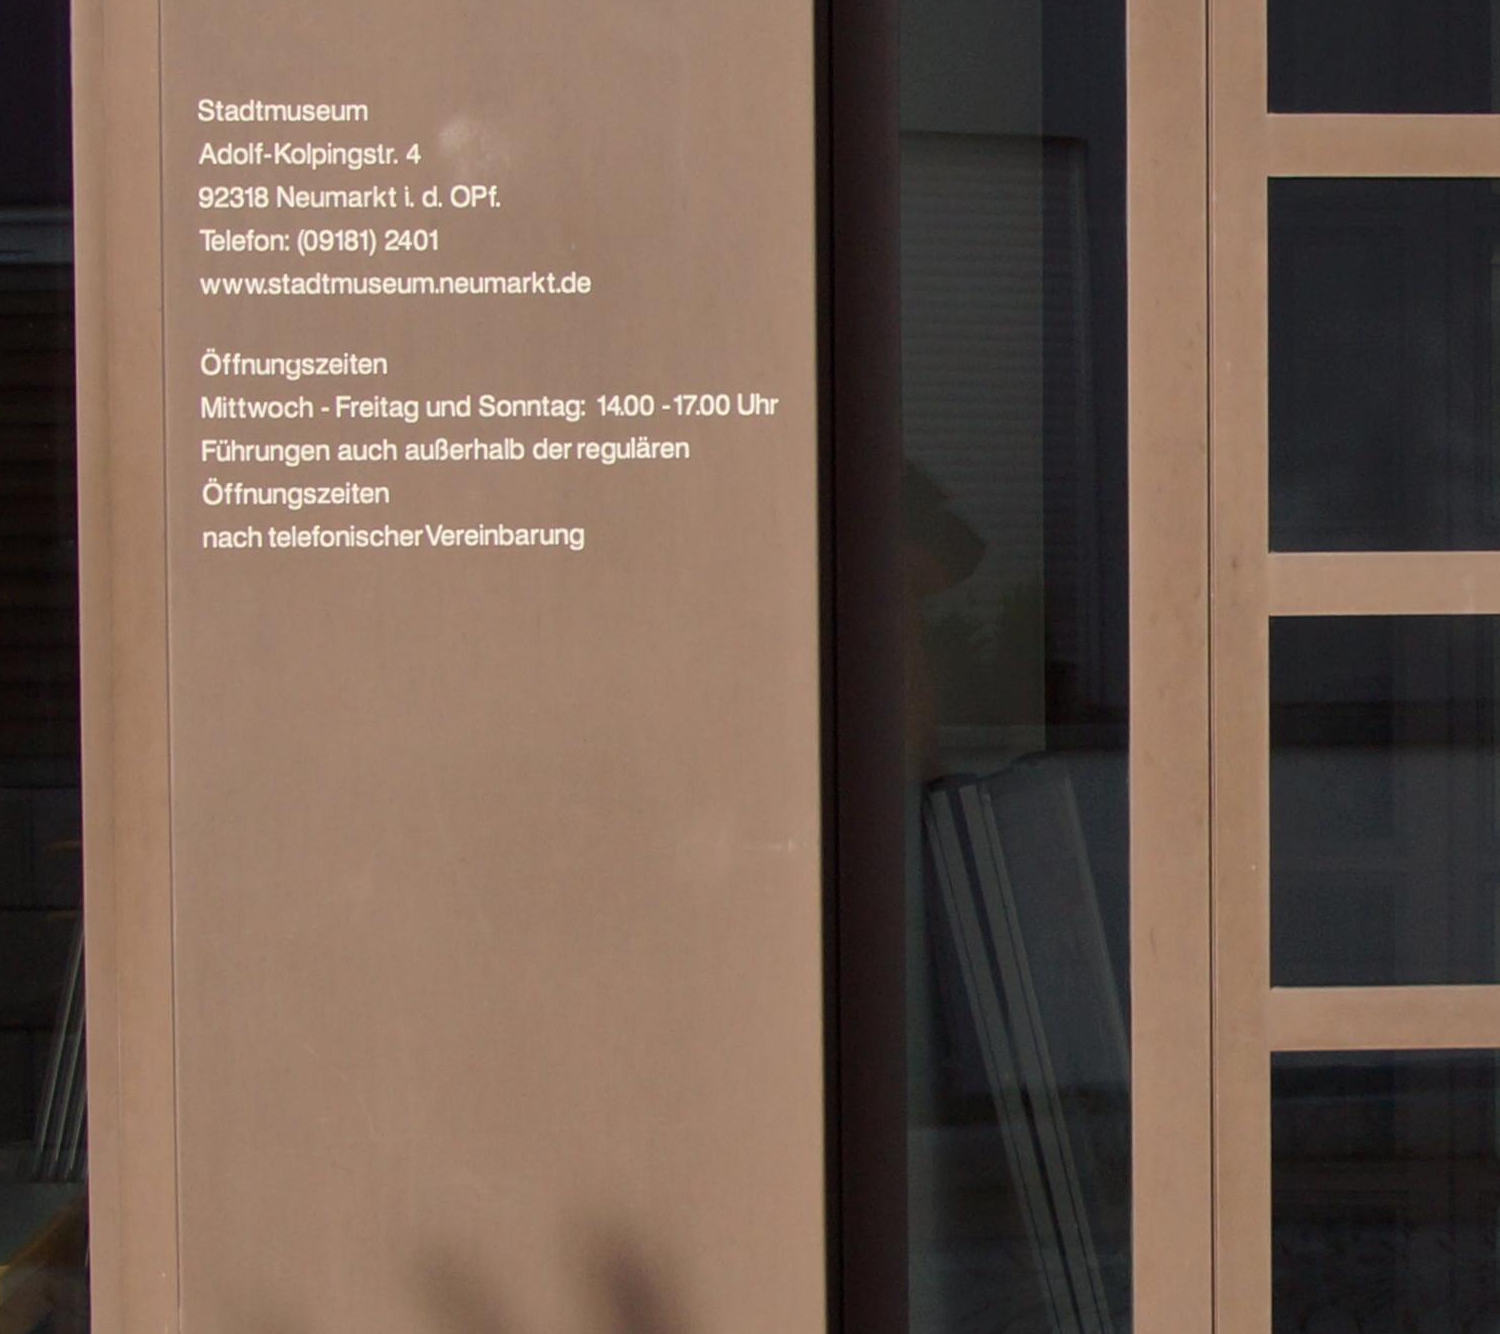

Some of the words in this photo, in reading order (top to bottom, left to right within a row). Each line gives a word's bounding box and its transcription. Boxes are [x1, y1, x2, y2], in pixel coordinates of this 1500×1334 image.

[197, 98, 369, 122] Stadtmuseum
[198, 141, 399, 171] Adolf-Kolpingstr.
[405, 142, 422, 165] 4
[197, 185, 270, 209] 92318
[276, 185, 397, 209] Neumarkt
[403, 185, 415, 208] i.
[421, 184, 443, 208] d.
[449, 184, 501, 209] OPf.
[198, 228, 291, 252] Telefon:
[296, 228, 377, 257] (09181)
[384, 228, 439, 252] 2401
[199, 270, 592, 296] www.stadtmuseum.neumarkt.de
[200, 347, 388, 382] Öffnungszeiten
[200, 395, 314, 419] Mittwoch
[335, 394, 420, 424] Freitag
[425, 394, 472, 418] und
[478, 394, 586, 423] Sonntag:
[596, 394, 655, 417] 14.00
[736, 392, 780, 416] Uhr
[201, 439, 331, 468] Führungen
[337, 438, 398, 462] auch
[404, 437, 526, 461] außerhalb
[531, 437, 573, 461] der
[576, 435, 691, 466] regulären
[202, 477, 390, 511] Öffnungszeiten
[202, 525, 263, 549] nach
[267, 524, 423, 549] telefonischer
[426, 524, 585, 551] Vereinbarung
